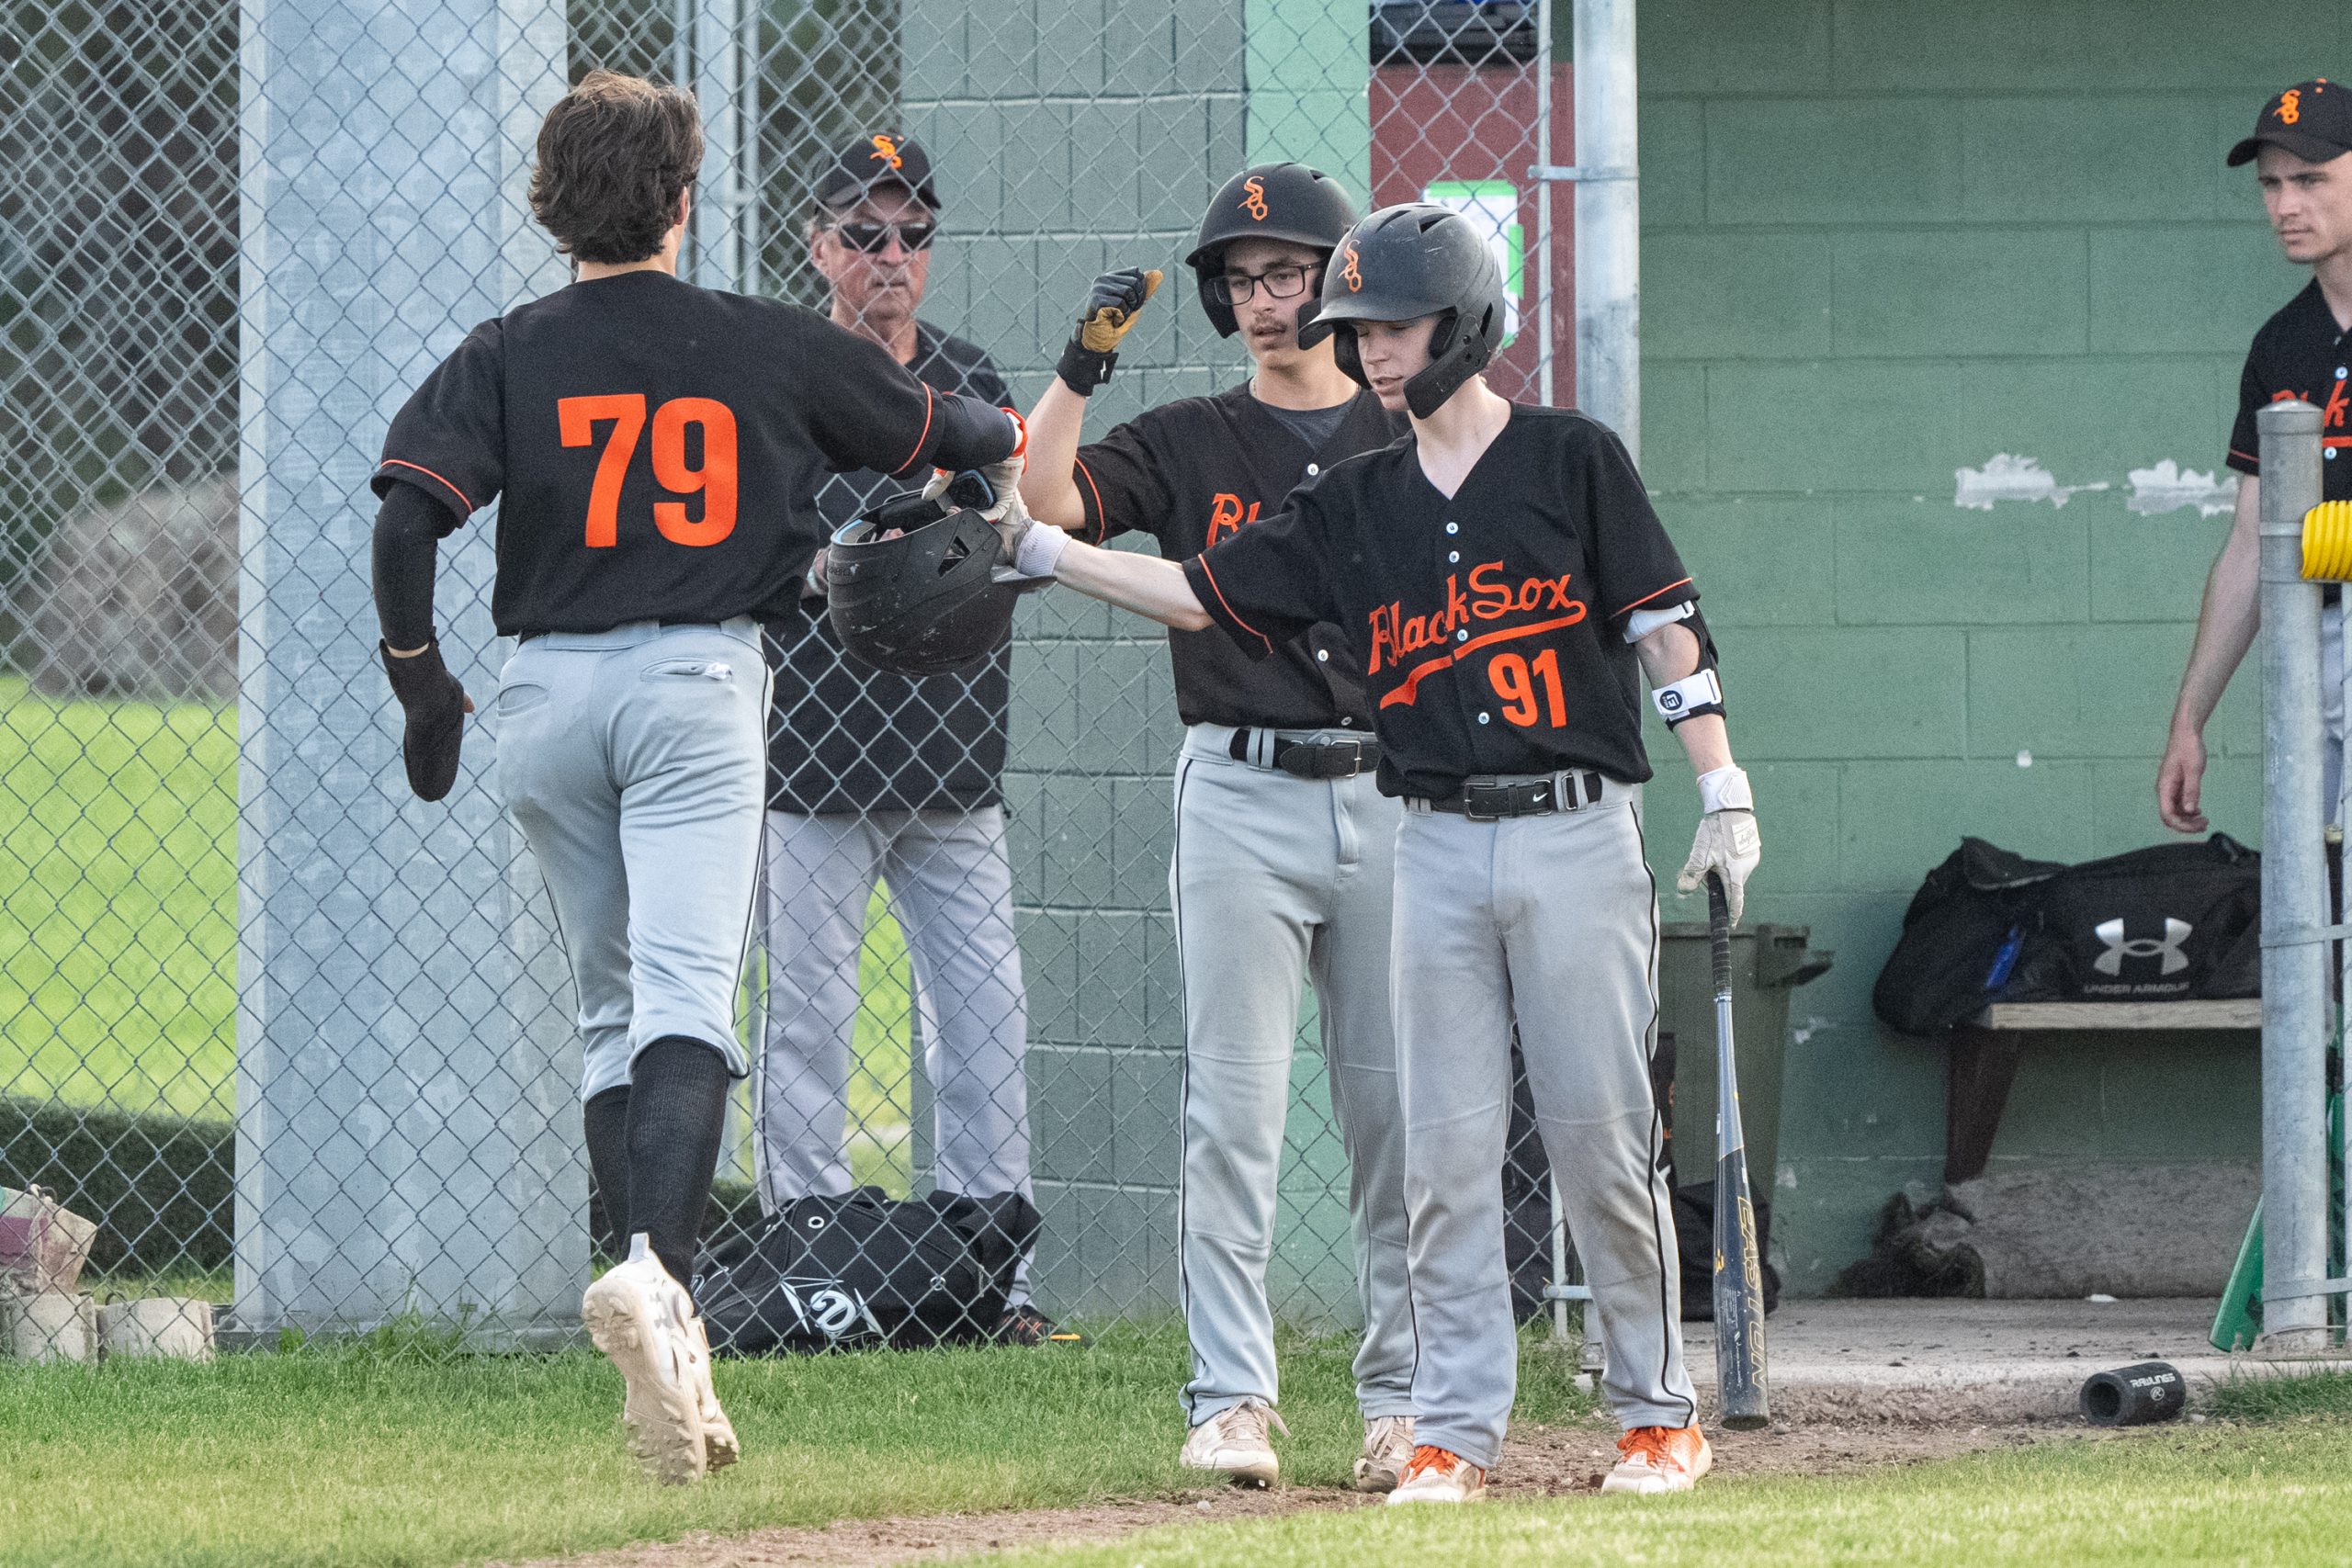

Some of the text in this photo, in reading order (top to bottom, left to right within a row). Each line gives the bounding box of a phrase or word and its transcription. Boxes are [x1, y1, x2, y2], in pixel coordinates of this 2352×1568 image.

[558, 393, 739, 548] 79
[1487, 649, 1567, 728] 91
[2083, 981, 2190, 995] UNDER ARMOUR
[2130, 1372, 2177, 1388] RAWLINGS
